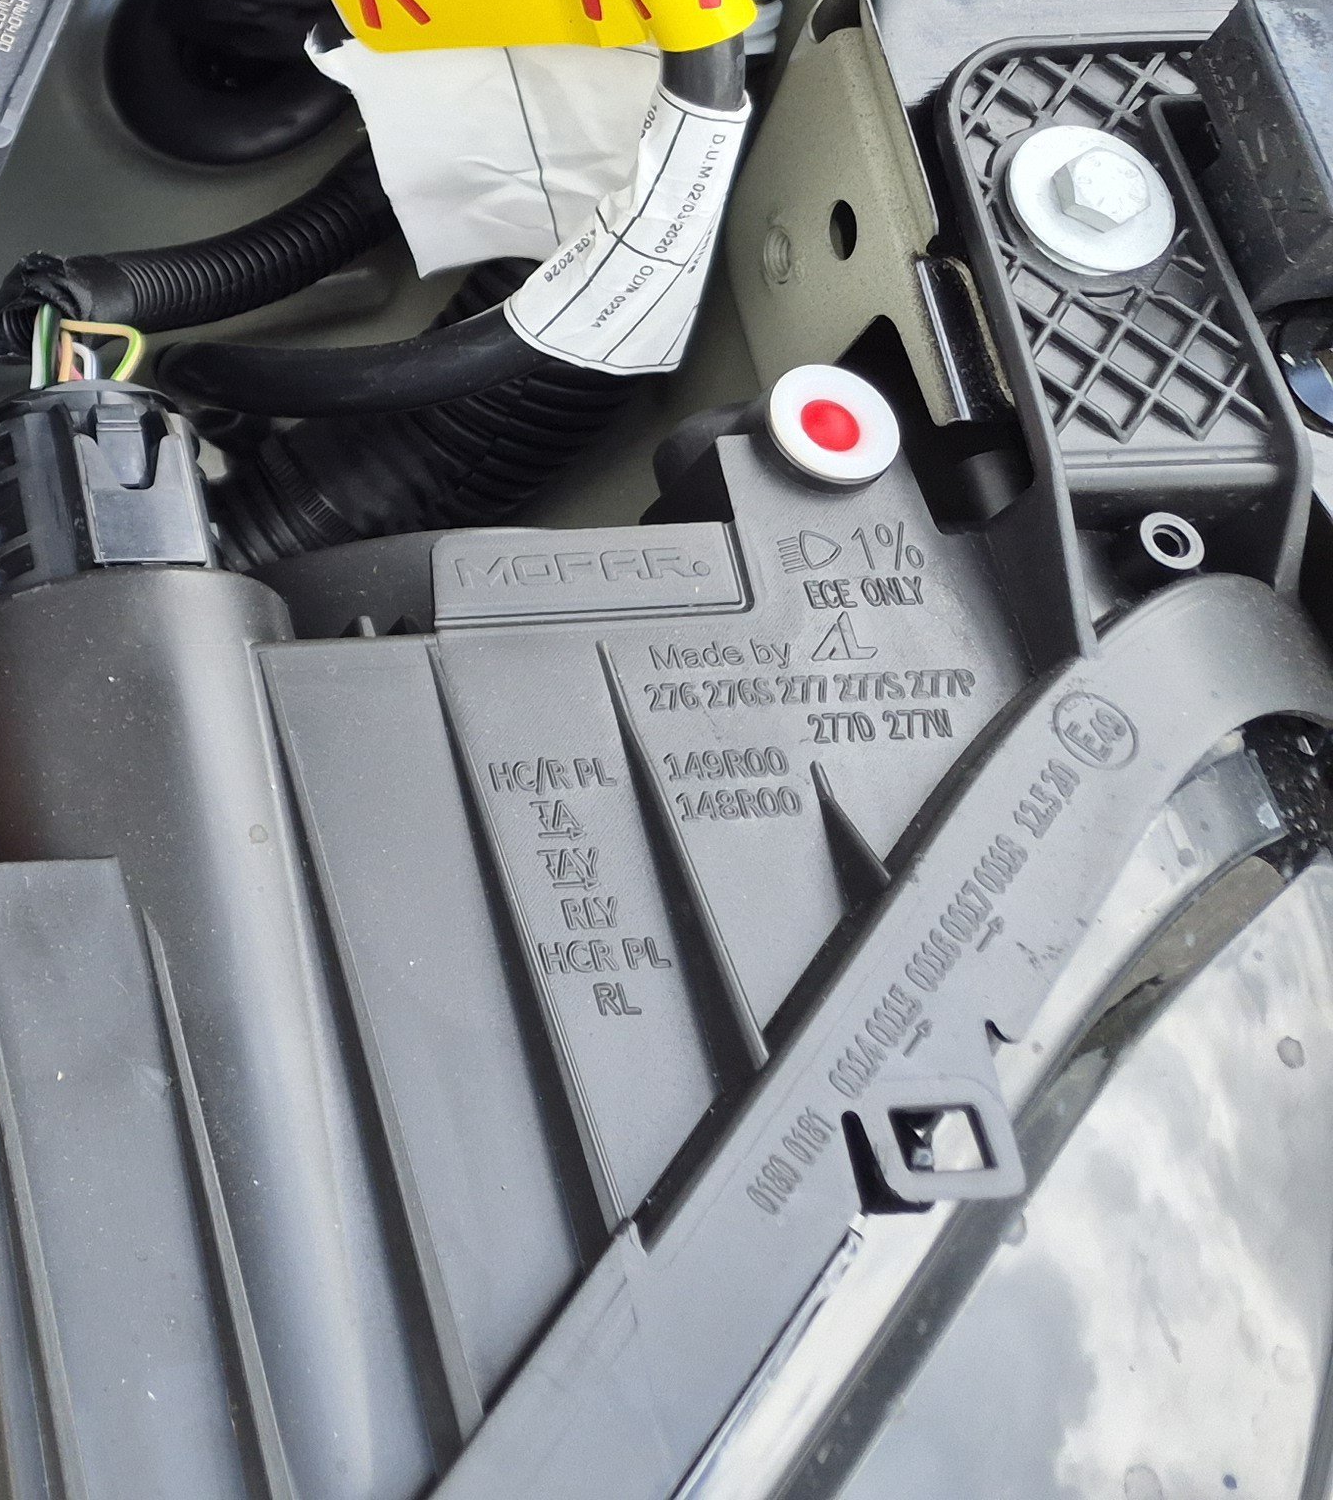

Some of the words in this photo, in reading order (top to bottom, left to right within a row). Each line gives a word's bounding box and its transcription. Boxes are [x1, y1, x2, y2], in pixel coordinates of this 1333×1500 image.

[851, 521, 924, 571] 1%
[804, 578, 858, 609] ECE
[861, 575, 924, 607] ONLY
[649, 641, 744, 671] Made
[750, 638, 792, 670] by
[644, 682, 700, 713] 276
[702, 677, 775, 710] 276S
[775, 674, 828, 706] 277
[833, 671, 906, 703] 277S
[904, 668, 976, 700] 277P
[882, 708, 954, 741] 277W
[488, 757, 573, 795] HC/R
[572, 757, 617, 788] PL
[663, 746, 790, 783] 149R00
[675, 786, 803, 822] 148R00
[560, 896, 618, 930] RLY
[537, 939, 620, 974] HCR
[621, 936, 672, 970] PL
[592, 981, 643, 1016] RL
